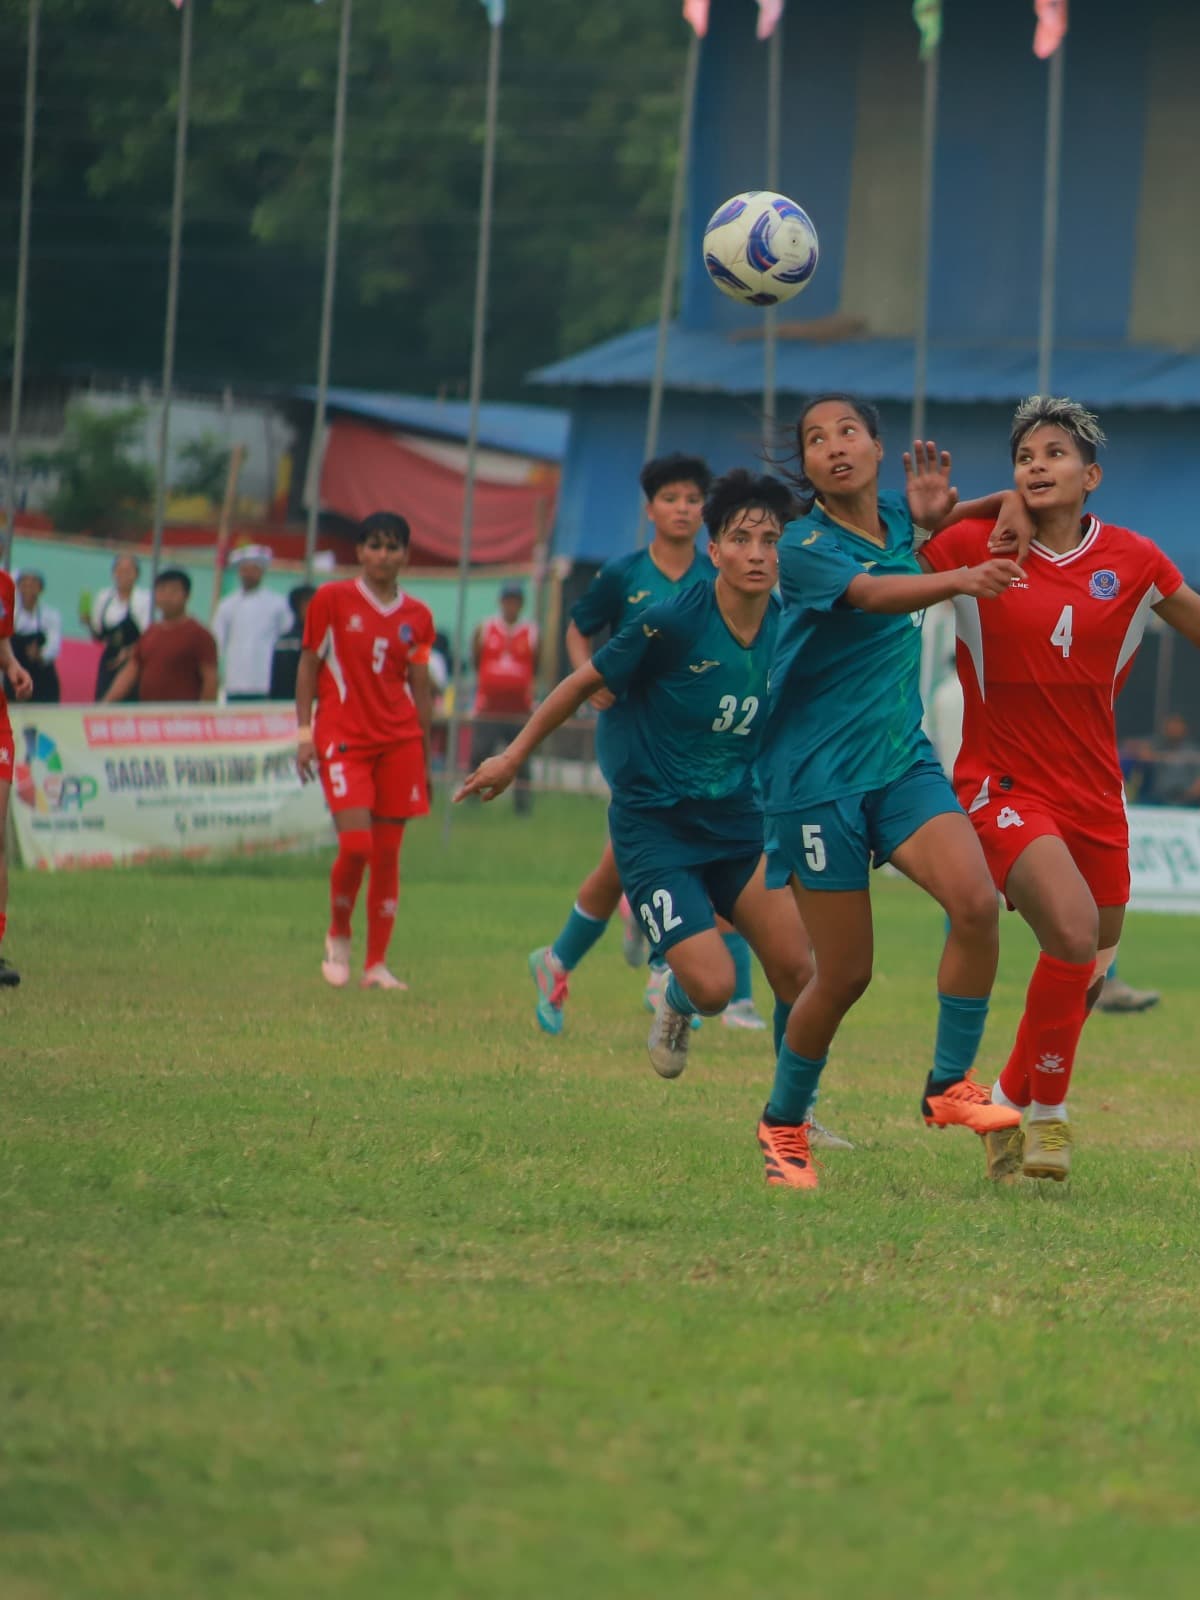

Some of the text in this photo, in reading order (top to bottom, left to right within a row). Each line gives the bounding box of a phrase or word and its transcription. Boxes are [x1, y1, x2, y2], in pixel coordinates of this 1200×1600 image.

[1050, 605, 1073, 658] 4
[372, 637, 389, 674] 5
[711, 694, 759, 736] 32
[173, 750, 259, 786] PRINTING
[328, 761, 348, 798] 5
[801, 824, 827, 873] 5
[639, 888, 683, 944] 32
